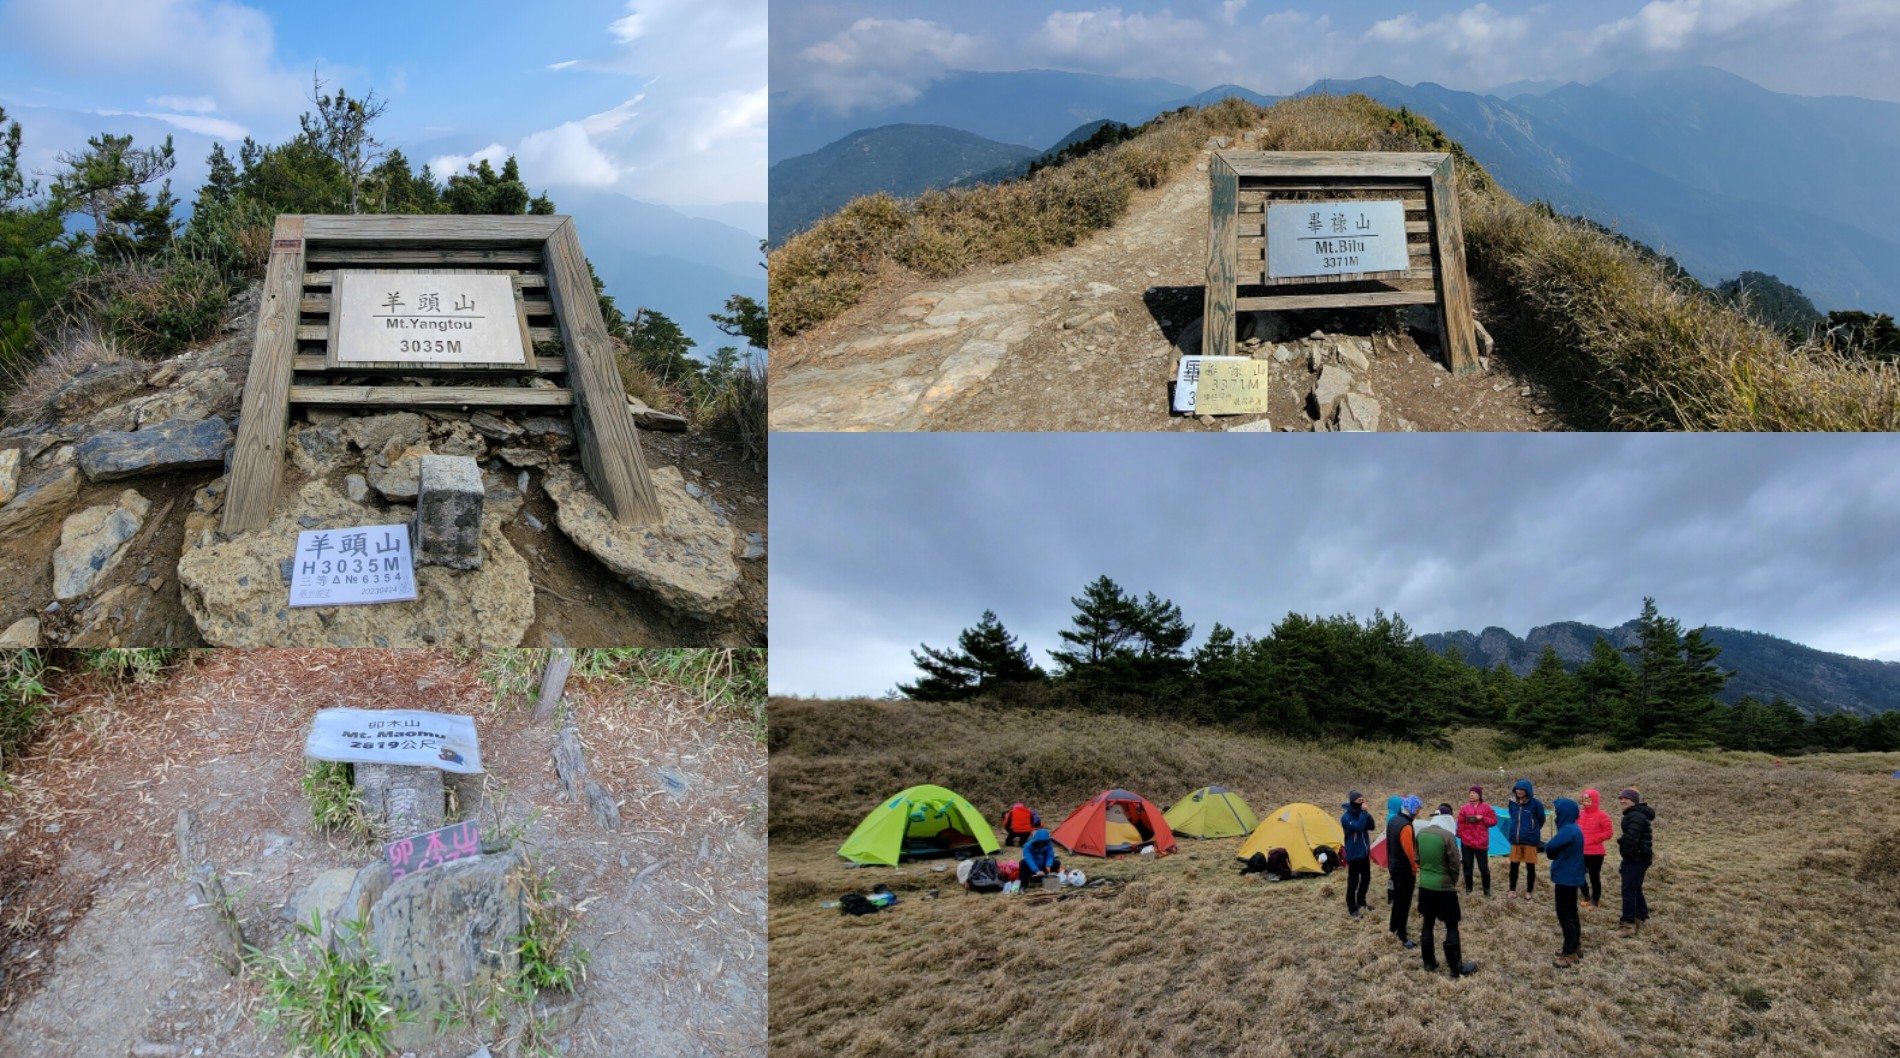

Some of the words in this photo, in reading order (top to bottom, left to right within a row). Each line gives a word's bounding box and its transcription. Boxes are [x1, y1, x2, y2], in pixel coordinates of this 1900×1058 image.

[1308, 212, 1370, 235] 畢祿山
[1323, 256, 1359, 268] 3371M
[381, 291, 475, 314] 羊頭山
[400, 340, 462, 353] 3035M
[305, 532, 400, 560] 羊頭山
[302, 557, 399, 575] H3035M
[341, 730, 372, 739] Mt.
[377, 730, 446, 740] Maomu
